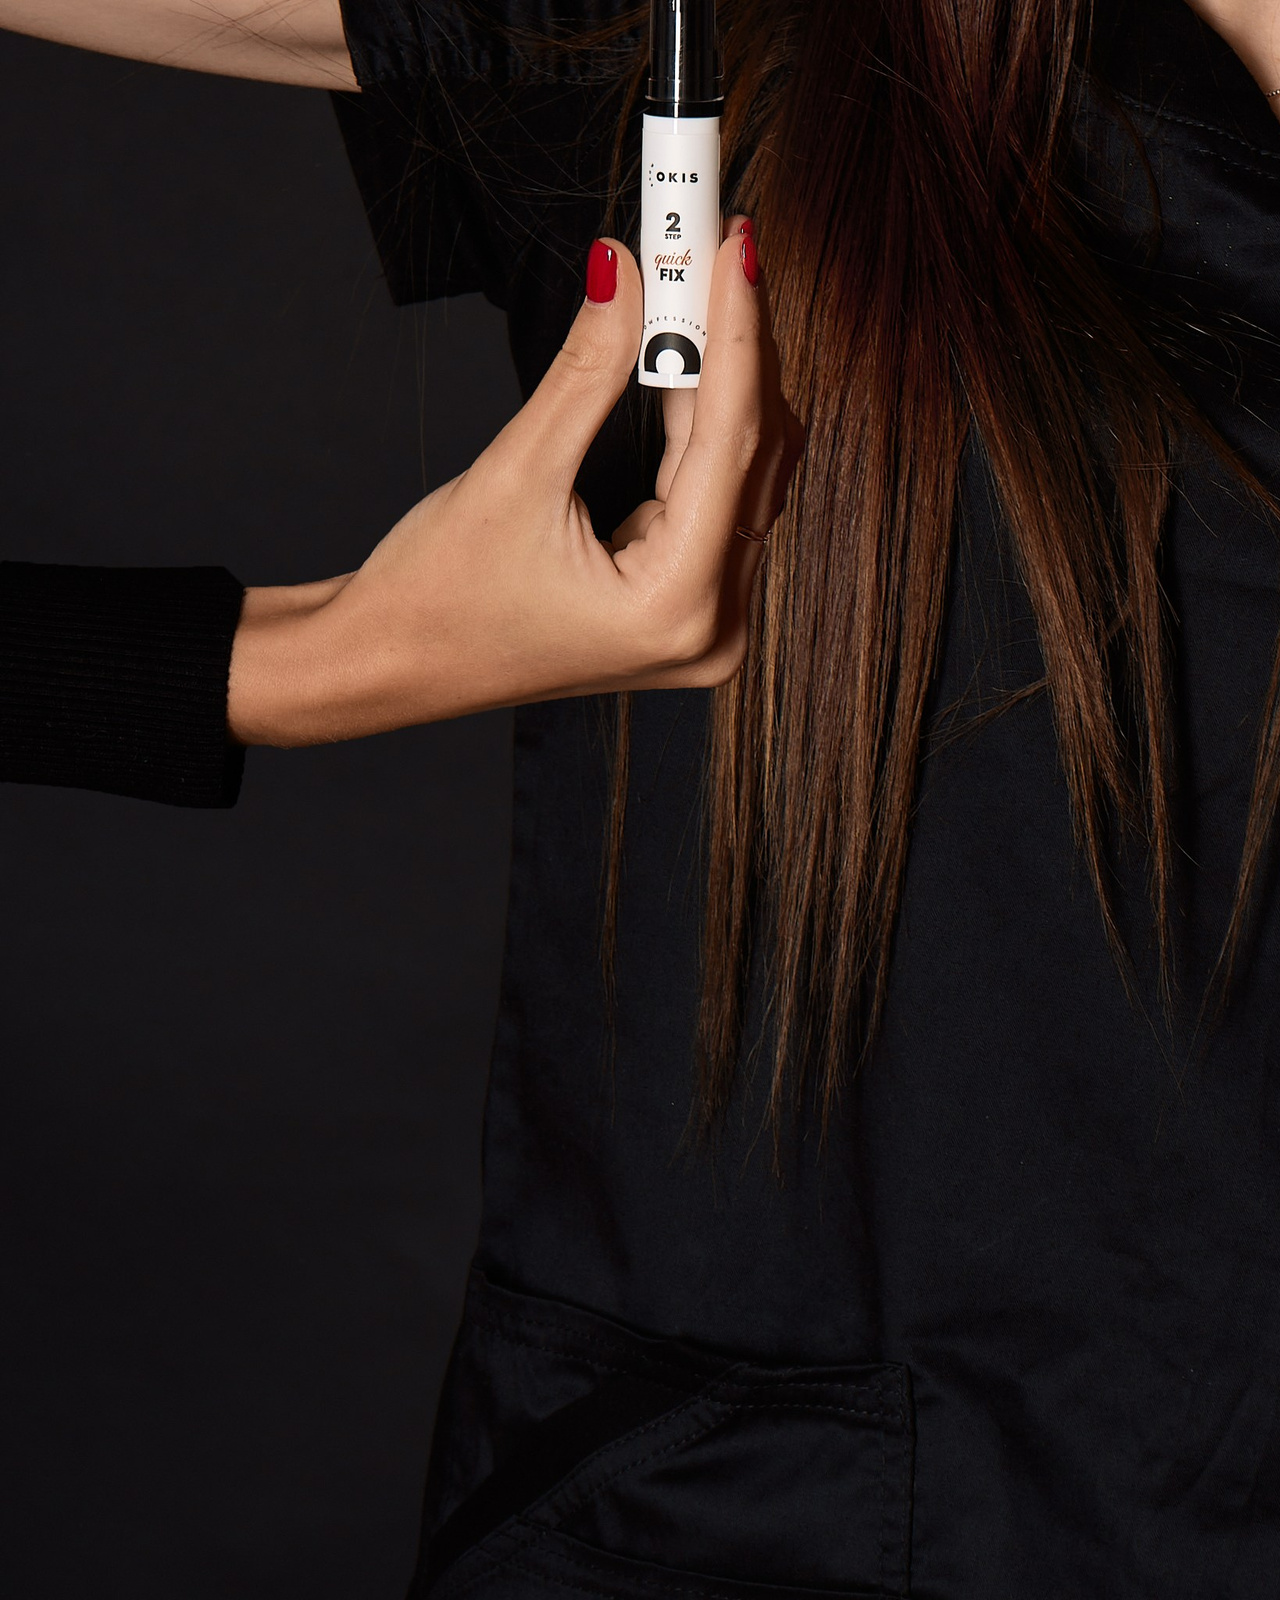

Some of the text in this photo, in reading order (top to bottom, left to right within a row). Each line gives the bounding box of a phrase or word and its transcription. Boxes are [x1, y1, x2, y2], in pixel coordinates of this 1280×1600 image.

[656, 171, 699, 184] OKIS
[666, 212, 681, 232] 2
[654, 248, 693, 271] quick
[660, 267, 685, 282] FIX
